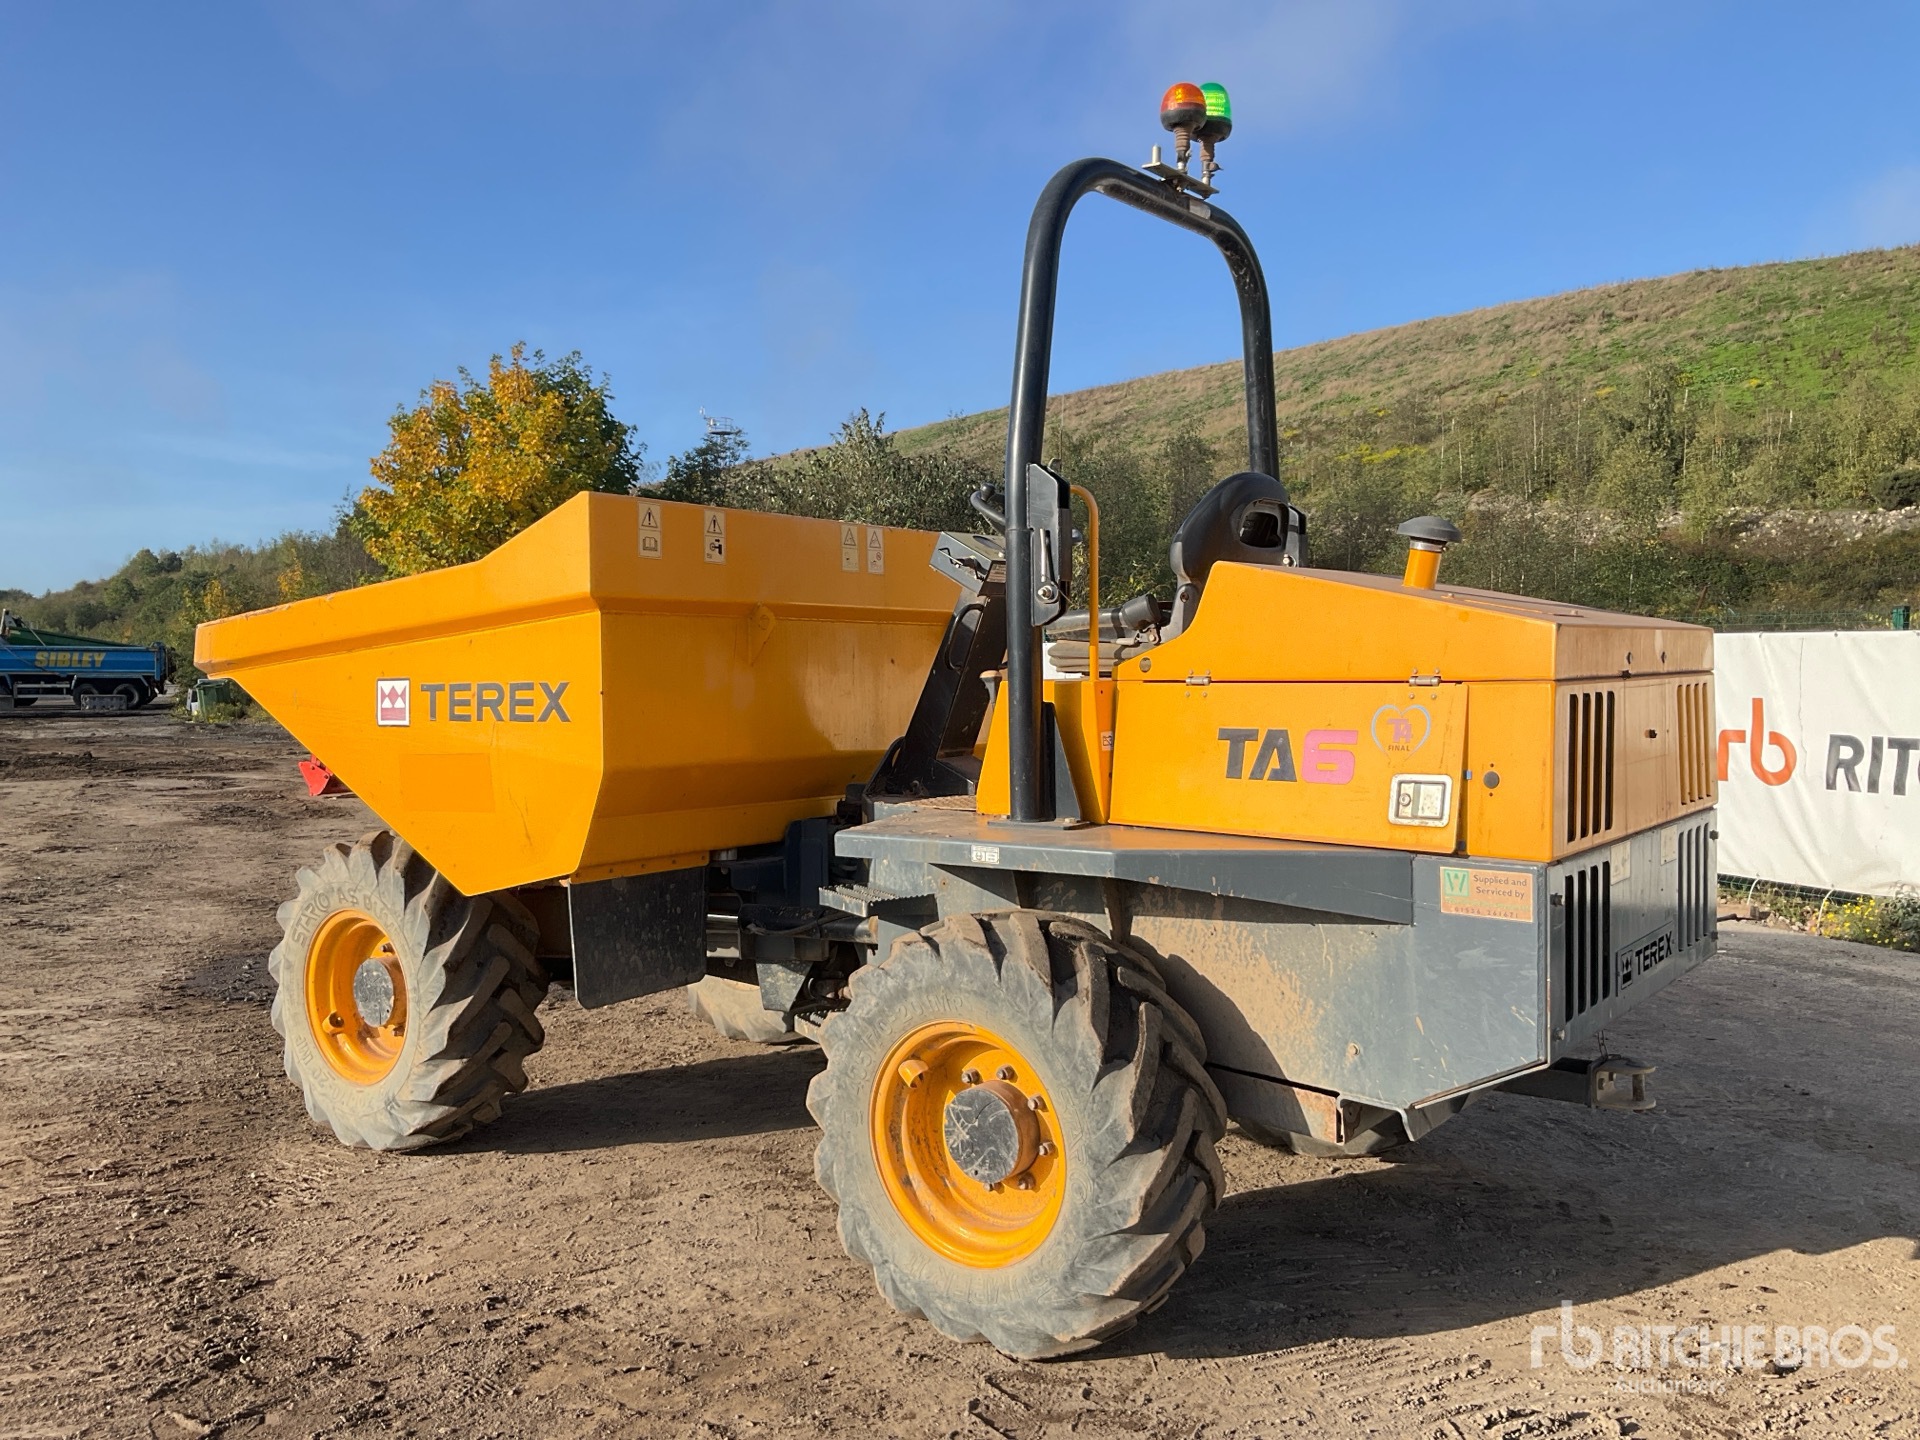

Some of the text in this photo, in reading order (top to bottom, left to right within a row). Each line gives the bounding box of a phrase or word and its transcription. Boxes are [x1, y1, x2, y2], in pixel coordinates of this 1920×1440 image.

[34, 651, 106, 668] SIBLEY
[420, 682, 571, 723] TEREX
[1217, 727, 1359, 785] TA6
[1387, 744, 1411, 752] FINAL
[1825, 733, 1920, 796] RIT
[1473, 874, 1527, 887] Supplied and
[1475, 886, 1525, 900] Serviced by
[1635, 930, 1673, 975] TEREX
